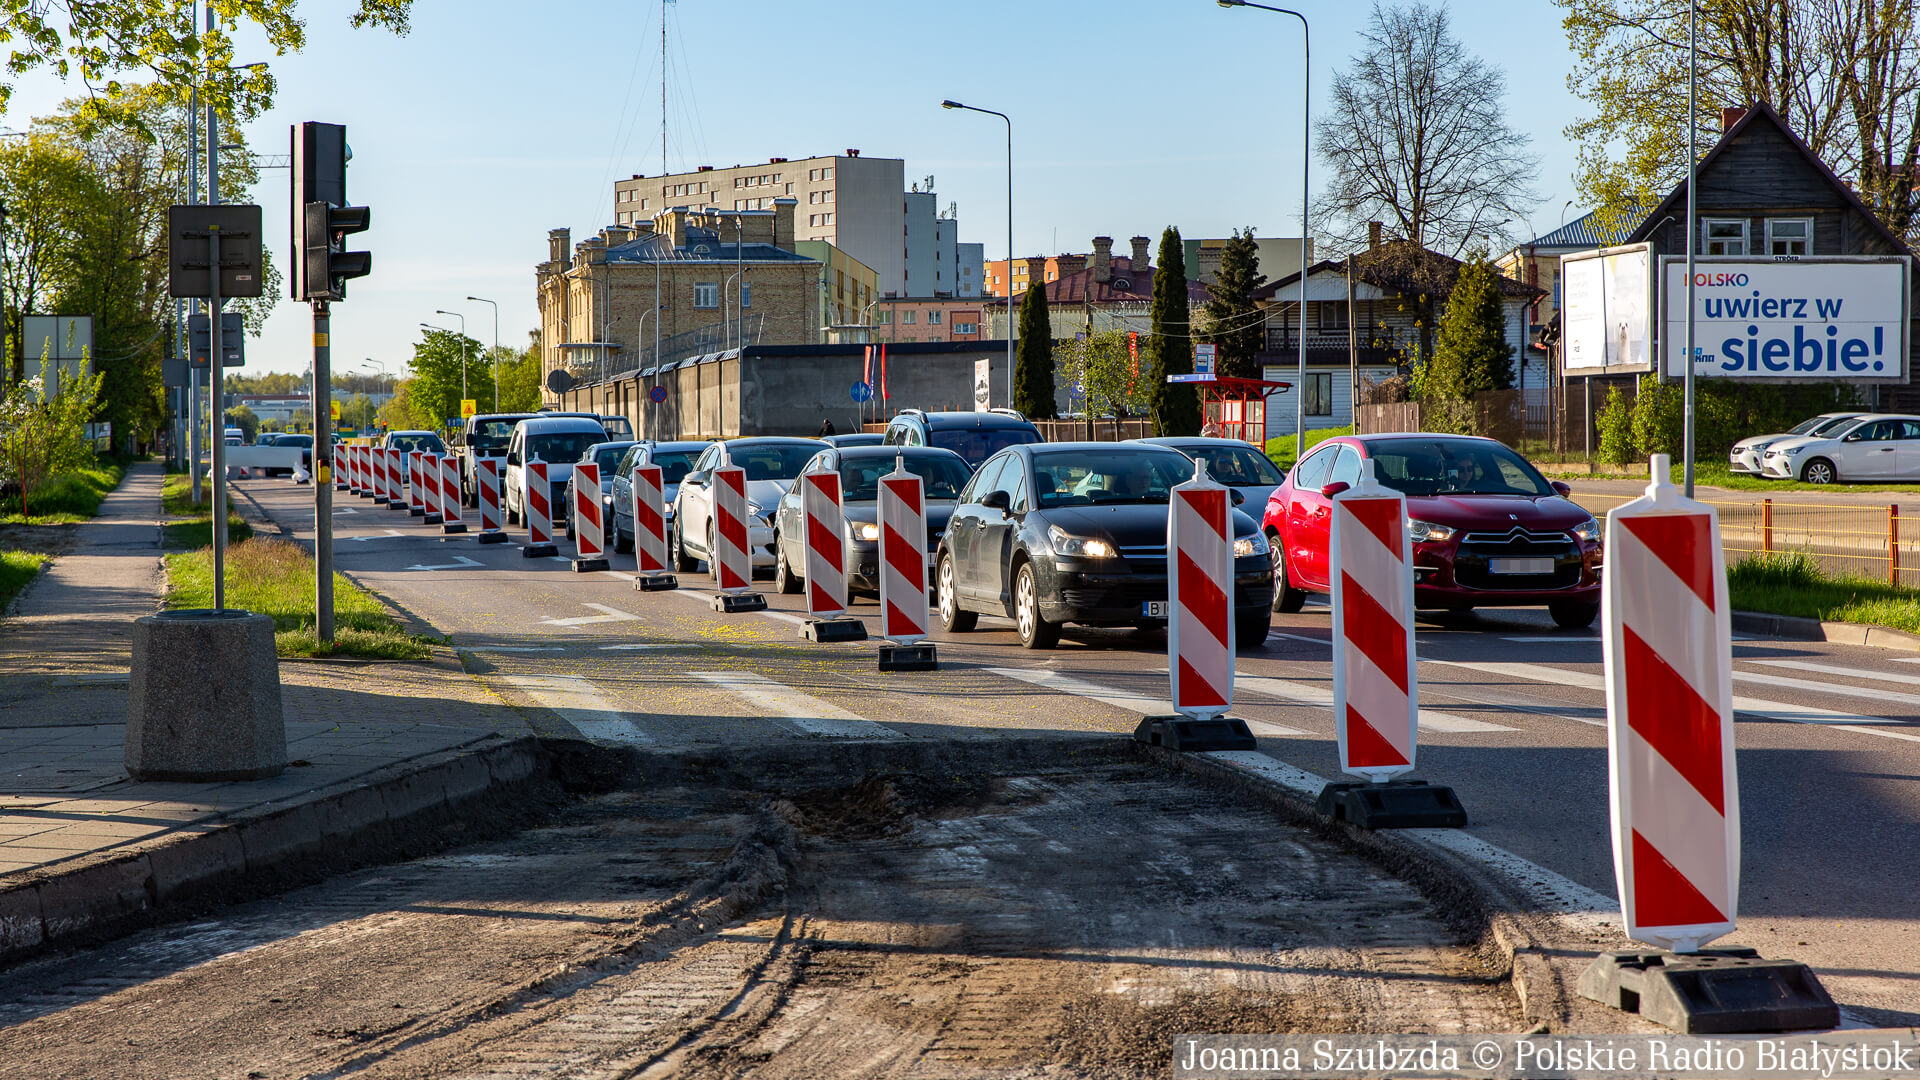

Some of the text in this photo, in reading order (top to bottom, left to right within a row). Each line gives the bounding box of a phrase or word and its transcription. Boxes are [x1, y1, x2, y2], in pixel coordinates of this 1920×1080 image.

[1705, 290, 1843, 318] uwierz w
[1721, 325, 1884, 372] siebie!
